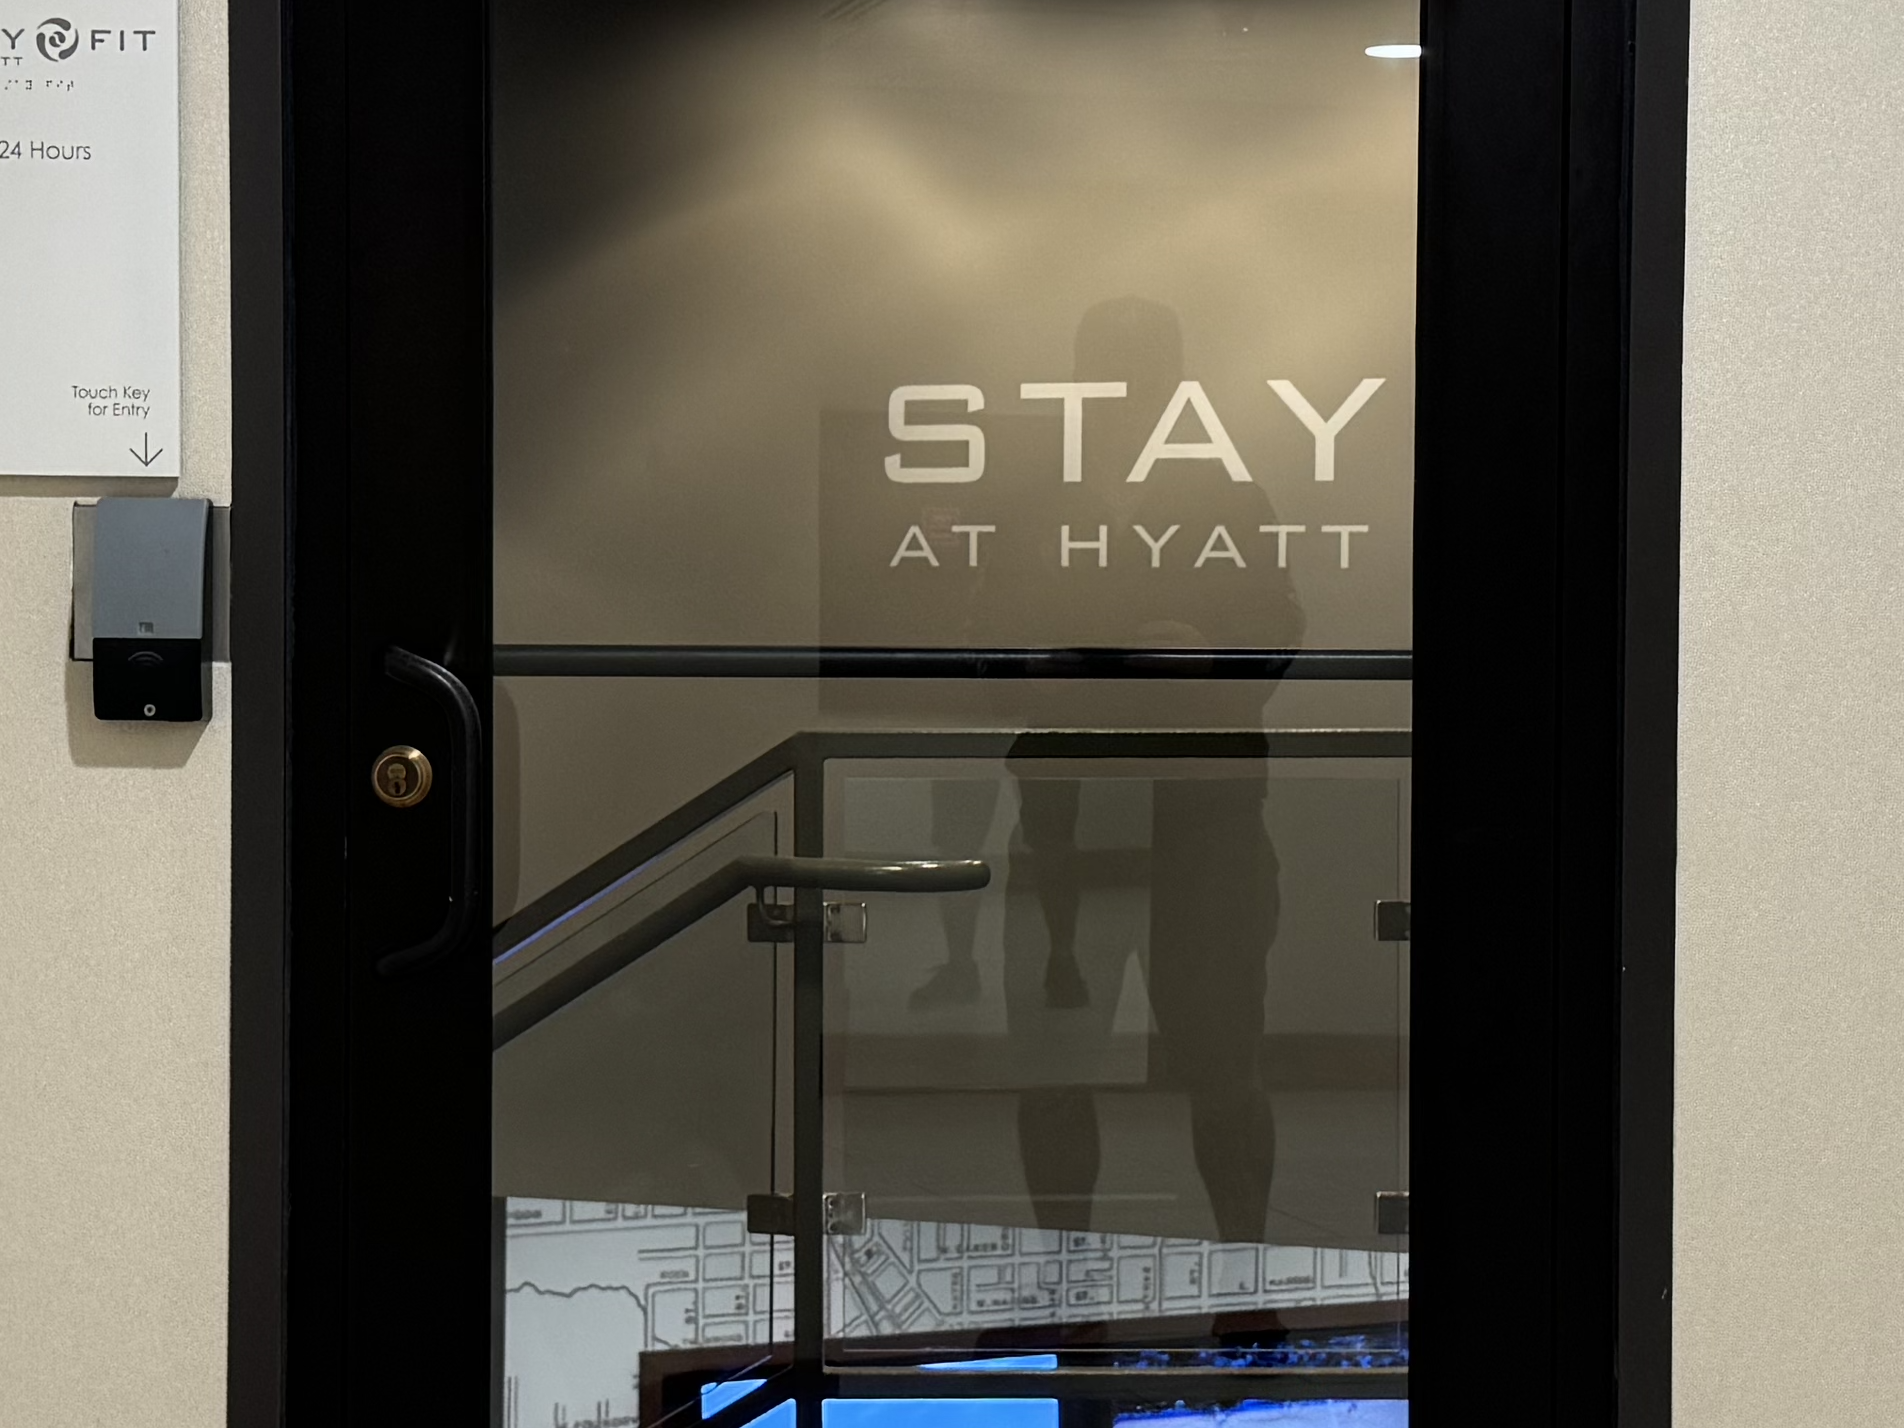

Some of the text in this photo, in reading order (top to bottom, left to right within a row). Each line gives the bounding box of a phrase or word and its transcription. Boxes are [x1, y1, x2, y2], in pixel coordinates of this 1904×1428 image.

[90, 29, 156, 52] FIT
[30, 140, 92, 161] Hours
[71, 385, 151, 402] Touch Key
[87, 402, 150, 420] for Entry
[884, 377, 1387, 484] STAY
[890, 524, 1370, 569] AT HYATT
